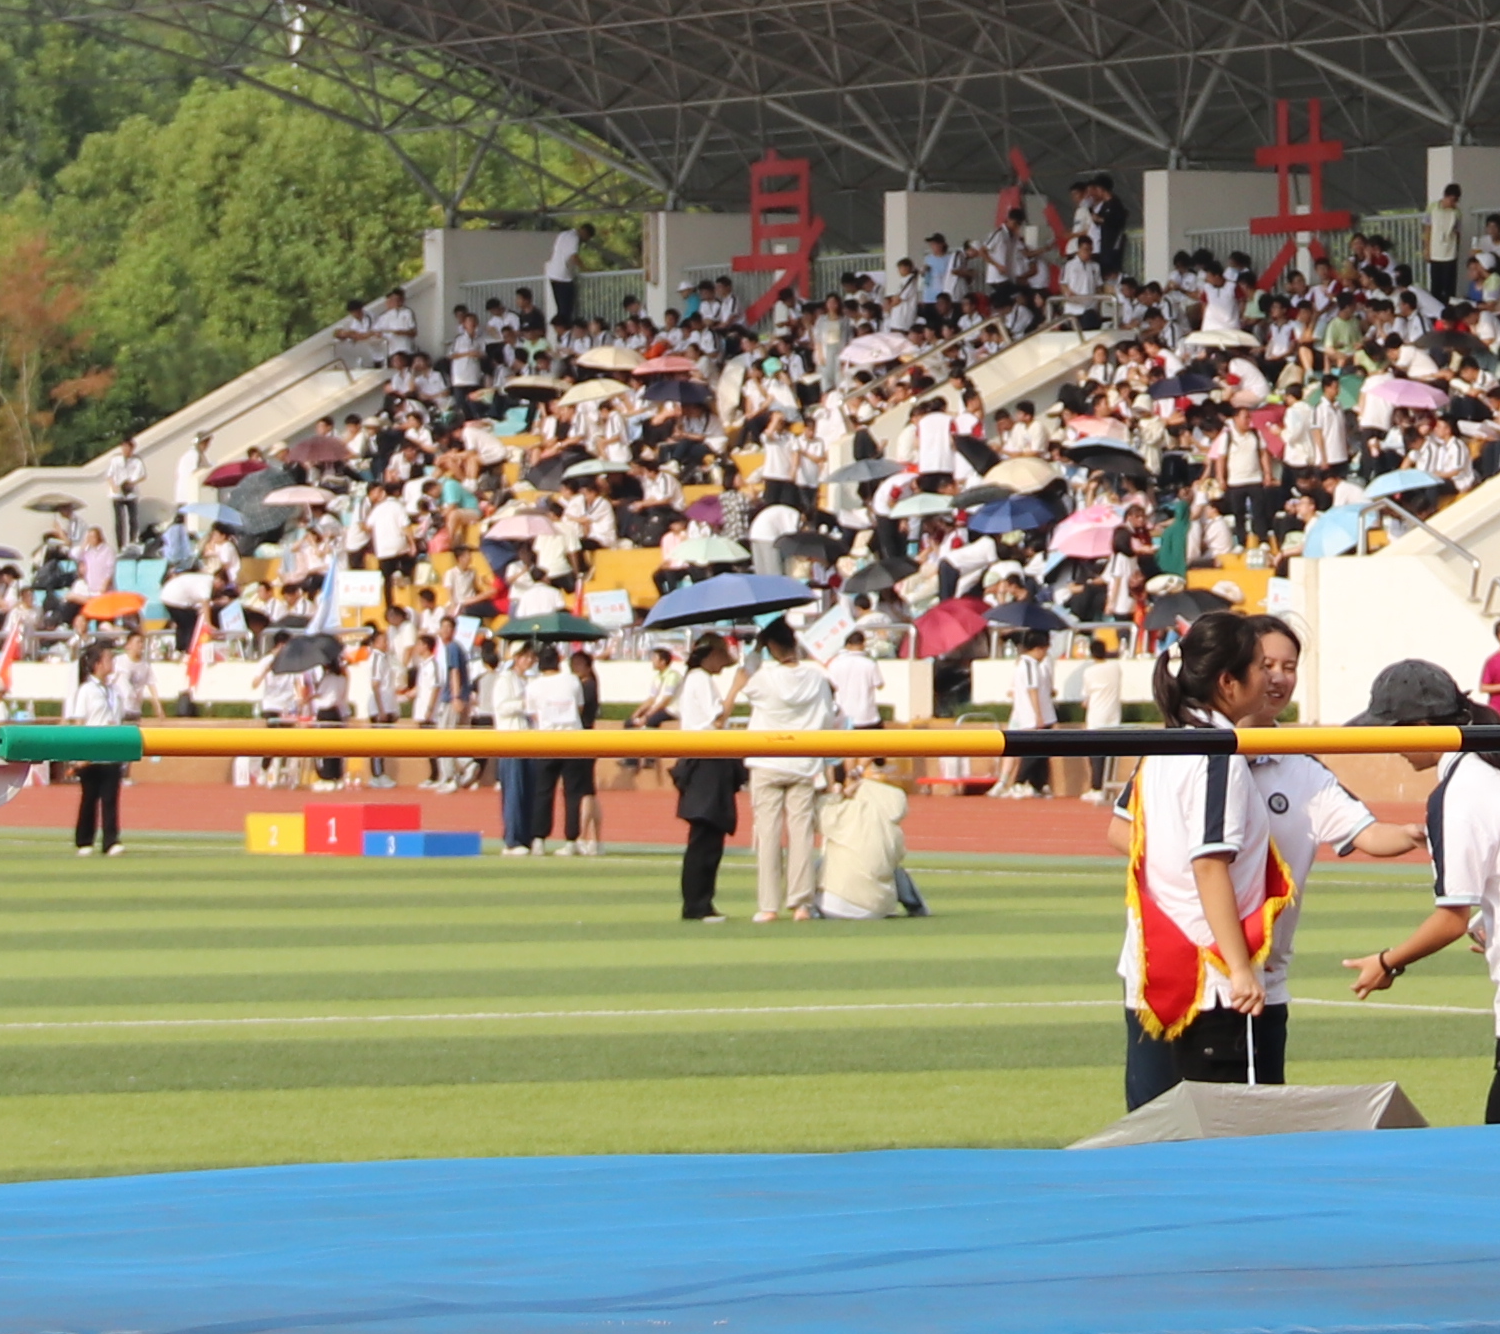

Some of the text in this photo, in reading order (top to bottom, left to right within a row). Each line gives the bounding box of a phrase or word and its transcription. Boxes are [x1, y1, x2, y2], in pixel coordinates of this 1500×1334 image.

[269, 825, 279, 847] 2
[327, 817, 338, 844] 1
[386, 835, 396, 856] 3
